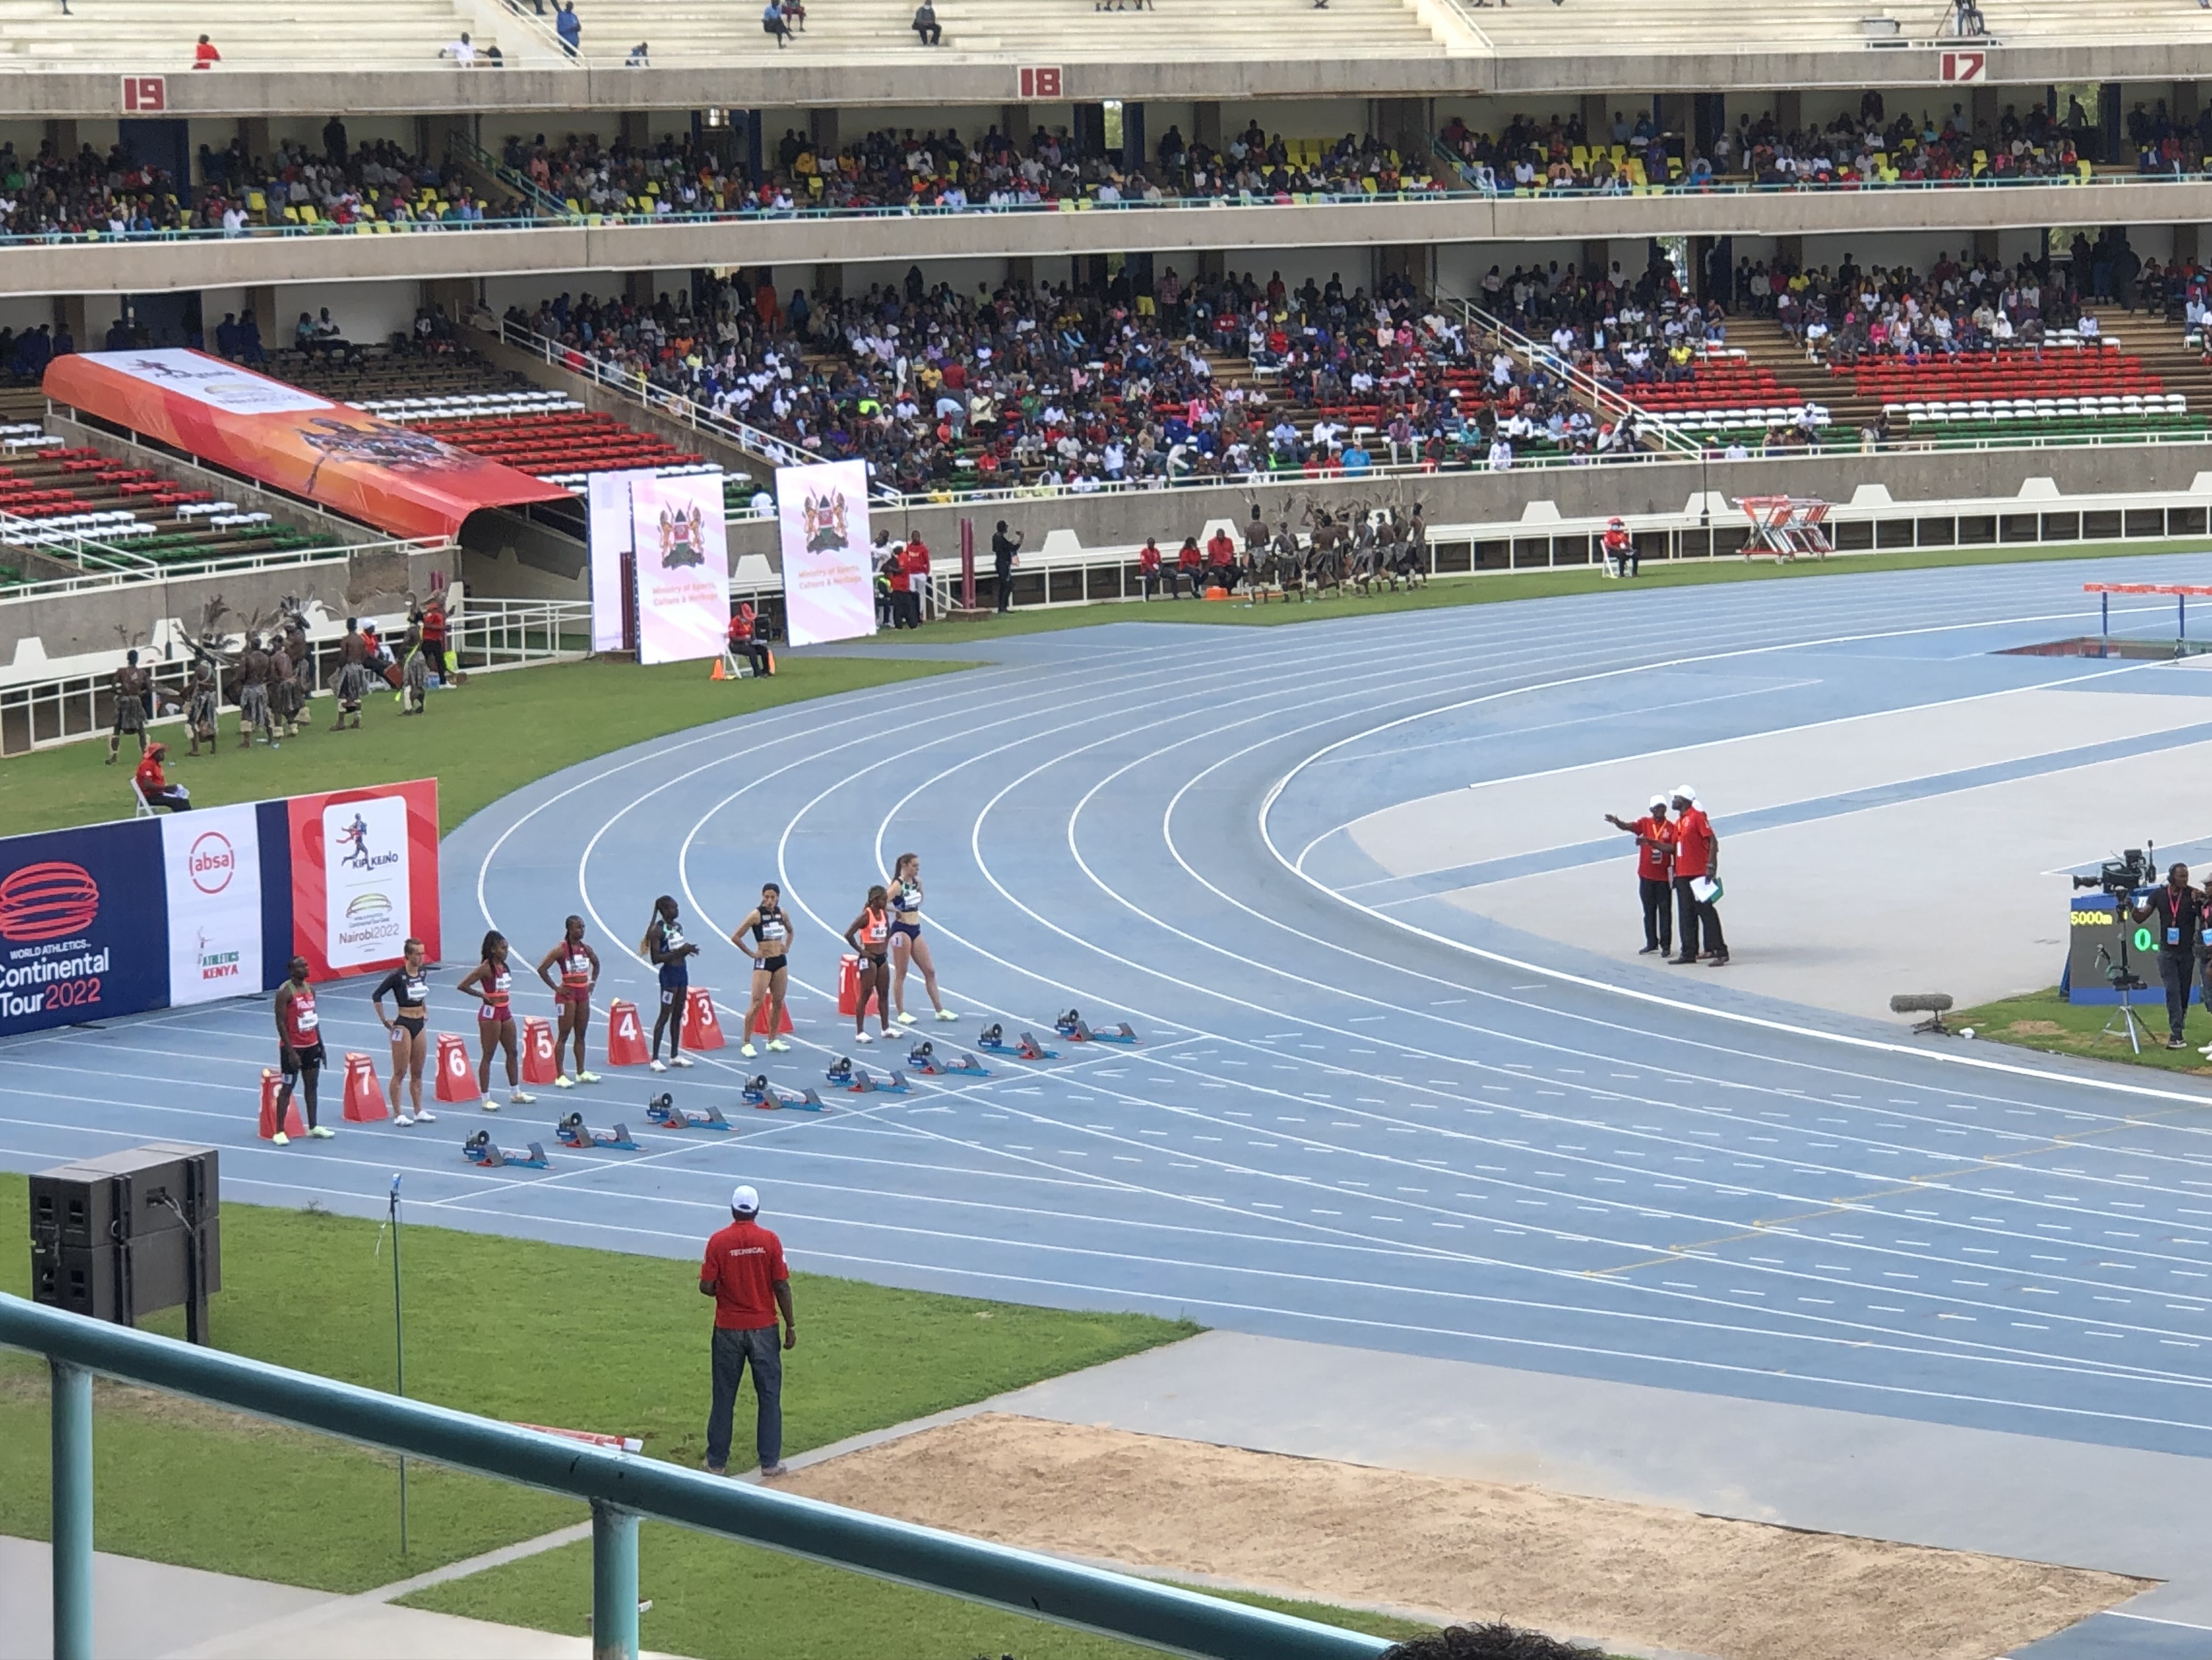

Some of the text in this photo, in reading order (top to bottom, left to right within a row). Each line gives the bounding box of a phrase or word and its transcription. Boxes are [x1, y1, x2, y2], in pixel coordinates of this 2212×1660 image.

[1943, 53, 1984, 81] 17
[1021, 68, 1060, 96] 18
[125, 78, 164, 110] 19
[799, 569, 826, 578] Ministry
[653, 586, 681, 594] Ministry
[799, 581, 824, 589] Culture
[195, 852, 229, 871] absa
[352, 851, 398, 869] KIP KEINO
[2070, 911, 2113, 926] 5000m
[10, 946, 41, 960] WORLD
[203, 951, 239, 967] ATHLETICS
[203, 964, 238, 980] KENYA
[698, 999, 712, 1025] 3
[619, 1013, 637, 1041] 4
[537, 1030, 552, 1058] 5
[450, 1048, 466, 1076] 6
[357, 1066, 370, 1095] 7
[729, 1247, 766, 1257] TECHNICAL
